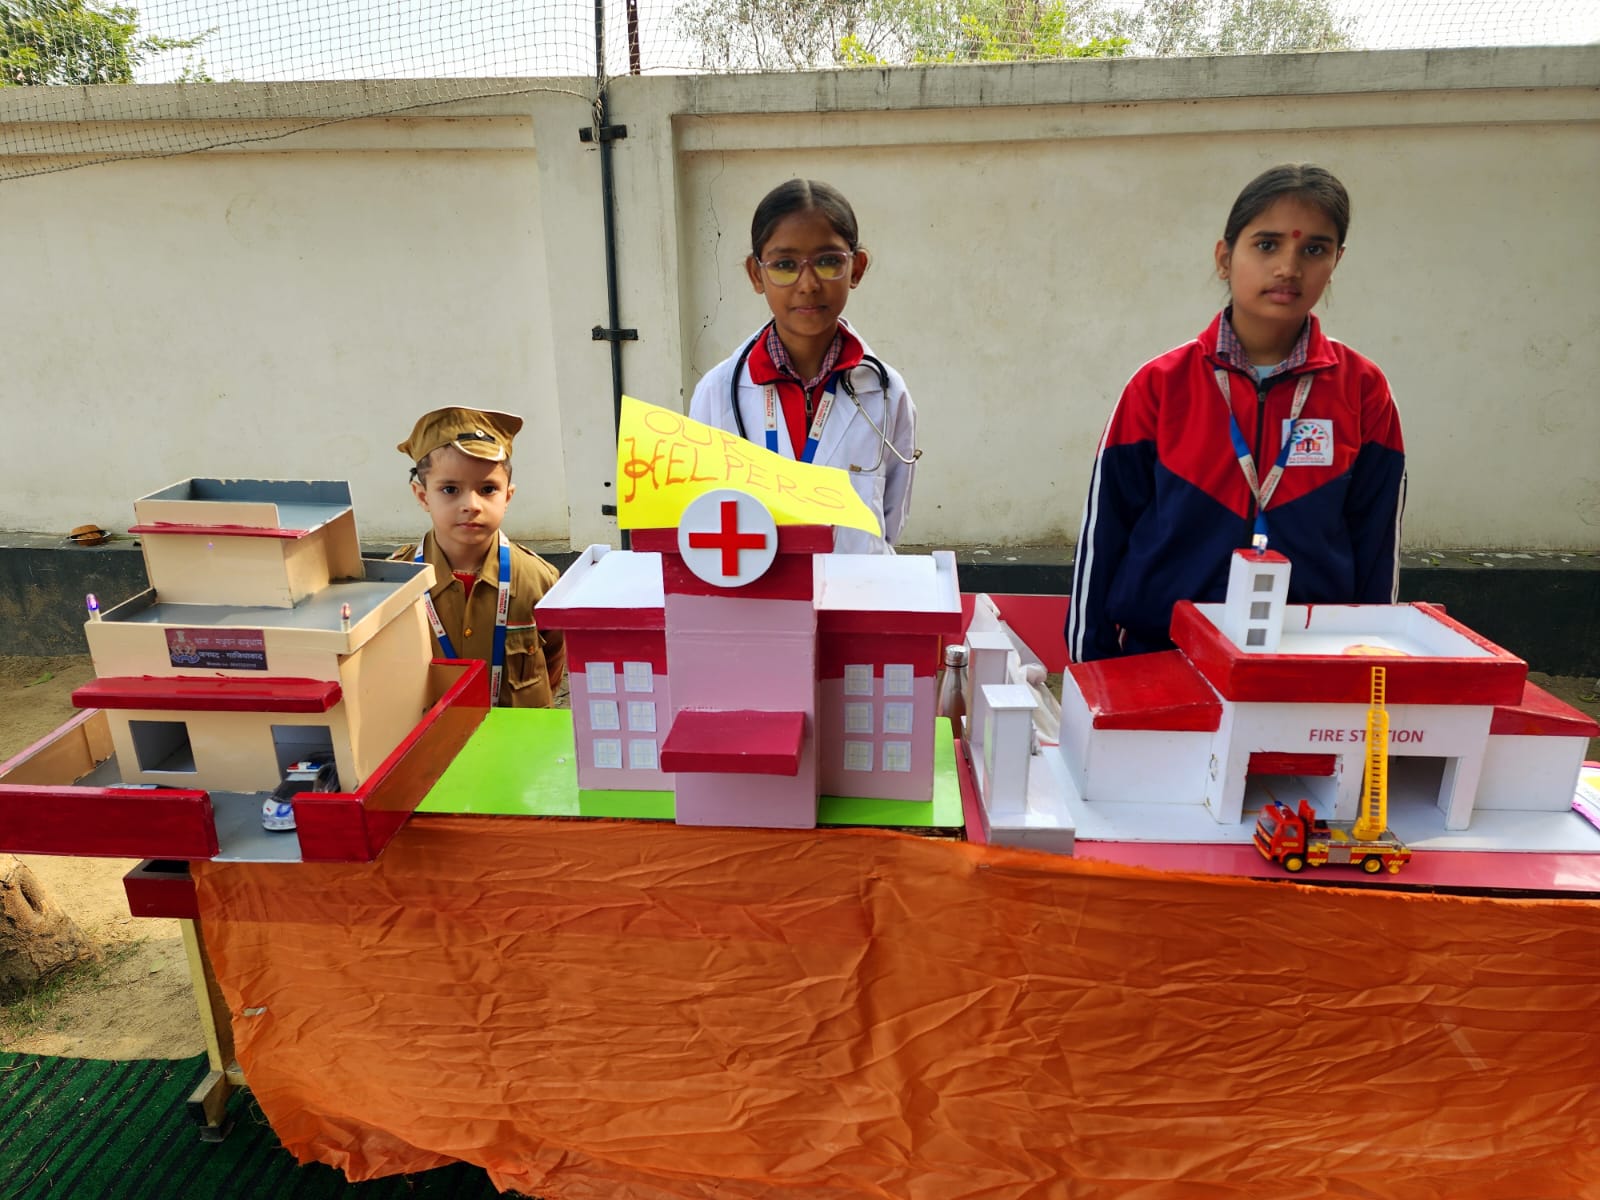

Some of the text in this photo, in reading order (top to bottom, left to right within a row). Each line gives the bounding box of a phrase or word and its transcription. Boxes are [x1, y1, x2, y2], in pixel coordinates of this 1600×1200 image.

[645, 411, 754, 461] OUR
[624, 437, 845, 510] HELPERS
[1309, 729, 1424, 743] FIRE STION
